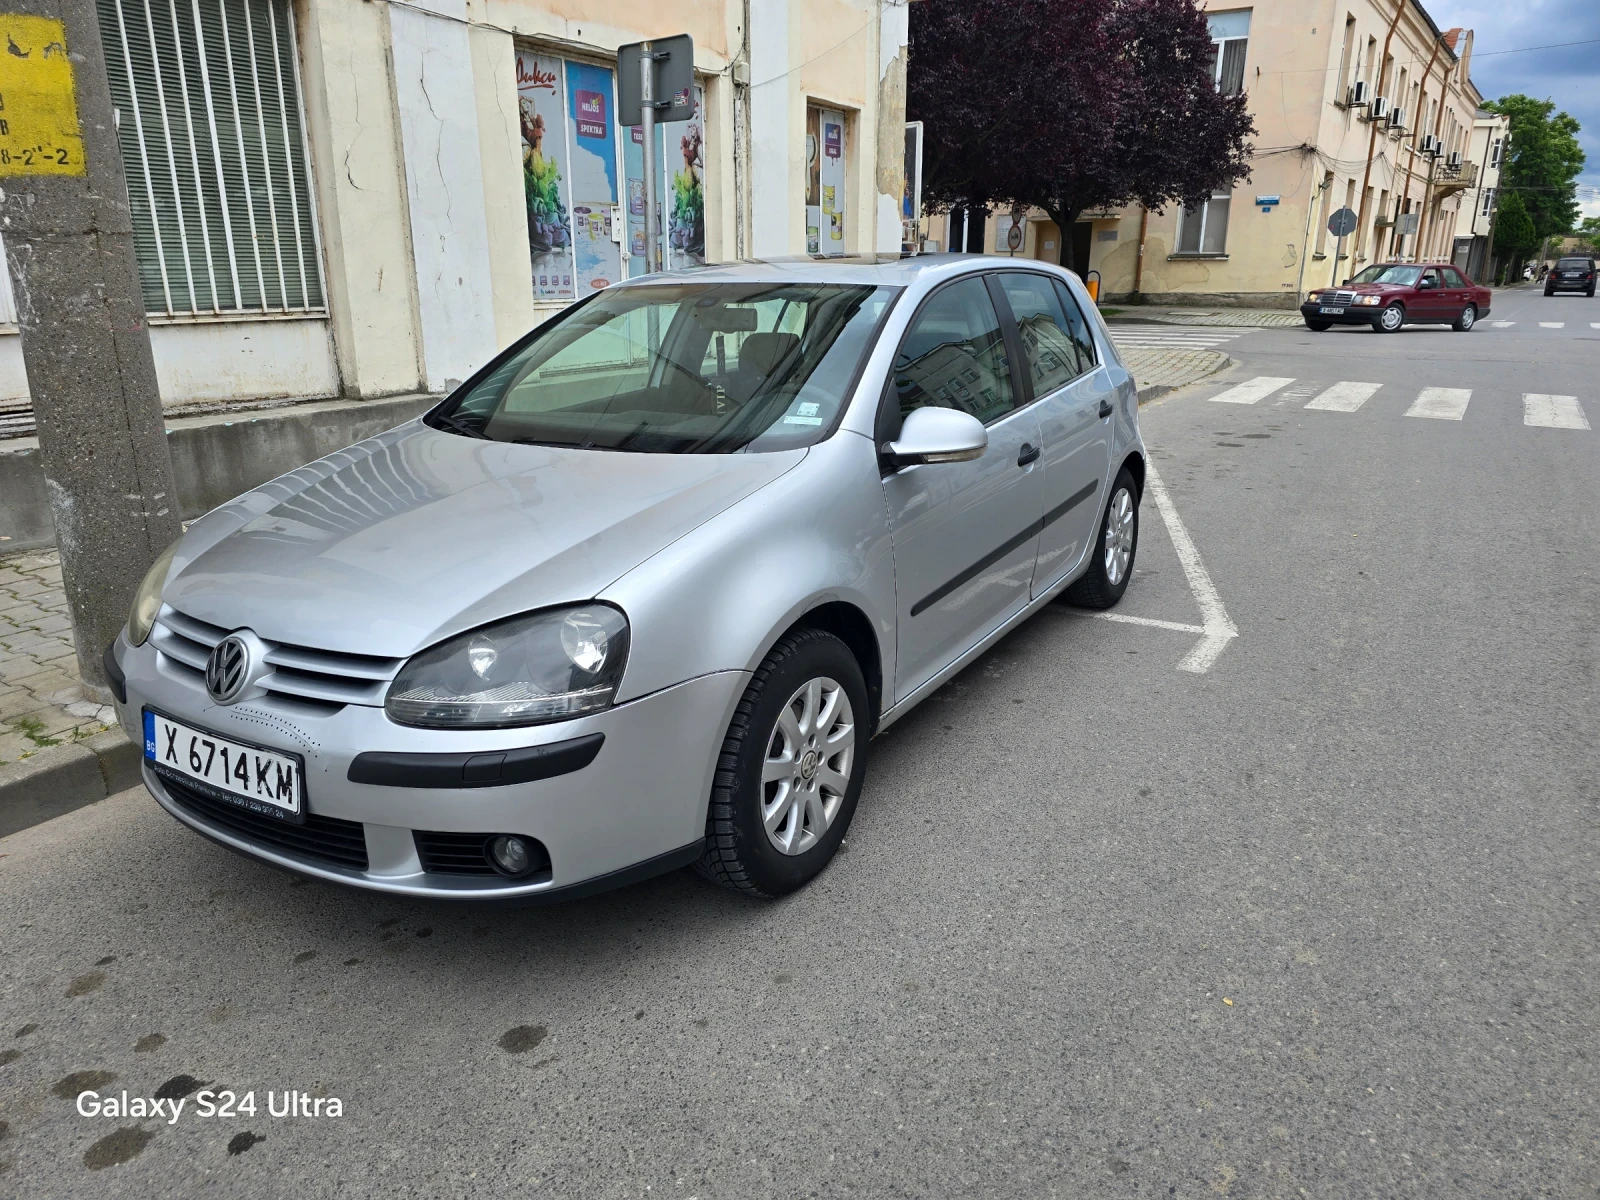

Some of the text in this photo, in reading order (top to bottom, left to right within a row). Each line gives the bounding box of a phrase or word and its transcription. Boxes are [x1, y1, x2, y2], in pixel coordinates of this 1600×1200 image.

[581, 102, 599, 113] HELIOS
[580, 124, 603, 135] SPEKTRA
[146, 739, 156, 753] BG
[164, 723, 293, 805] X 6714 KM
